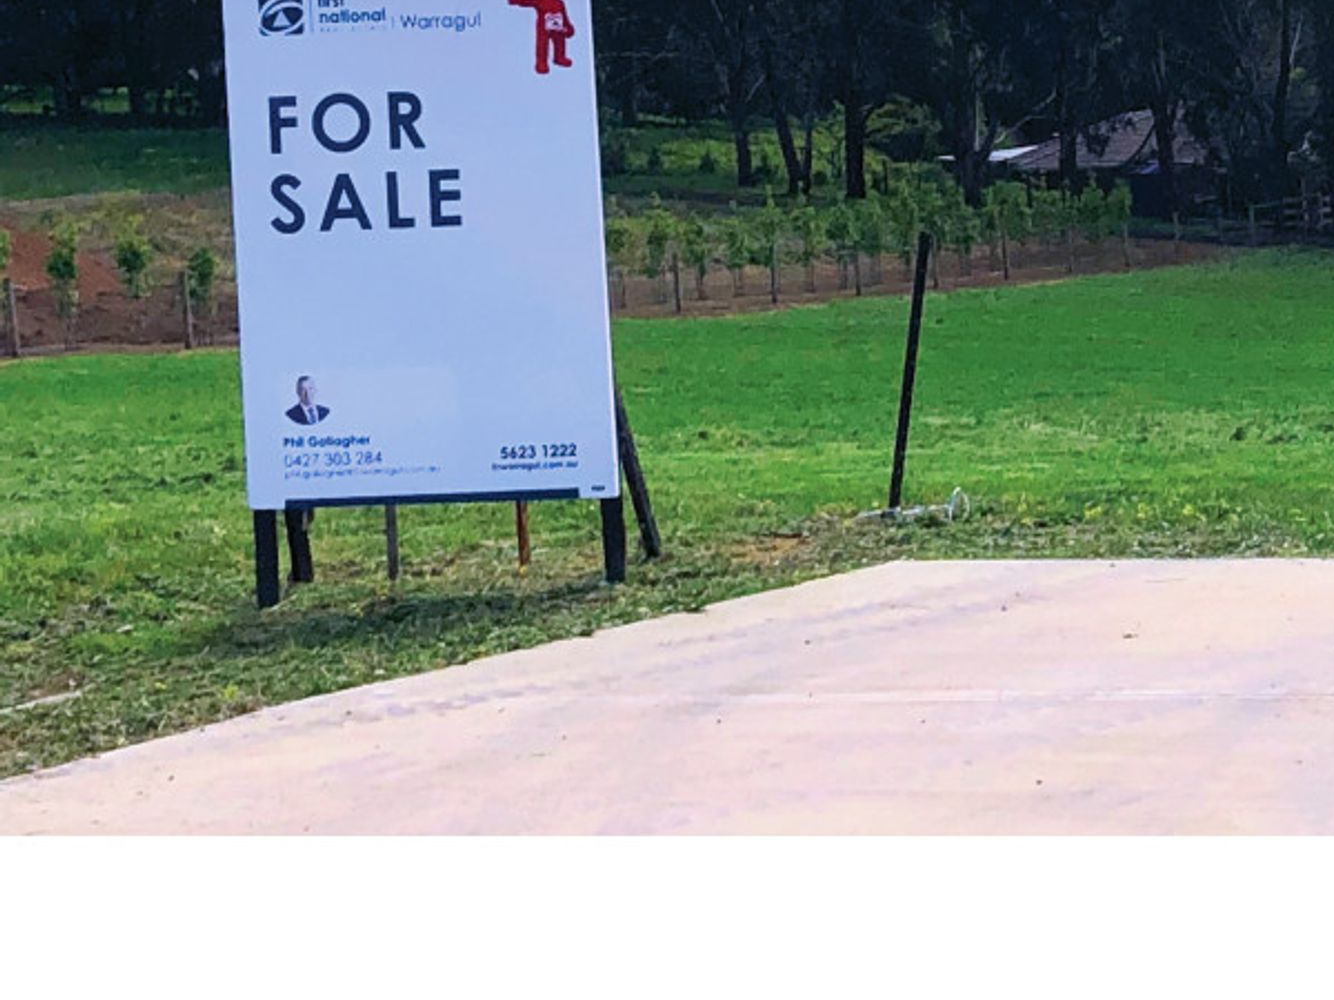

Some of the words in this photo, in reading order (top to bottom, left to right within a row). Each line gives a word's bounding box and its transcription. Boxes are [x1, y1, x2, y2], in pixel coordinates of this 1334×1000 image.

[319, 7, 386, 23] national
[400, 10, 482, 32] Warragul
[267, 91, 426, 154] FOR
[270, 168, 463, 235] SALE
[284, 452, 319, 468] 0427
[324, 451, 351, 467] 303
[355, 450, 382, 465] 284
[500, 445, 536, 459] 5623
[542, 443, 577, 457] 1222
